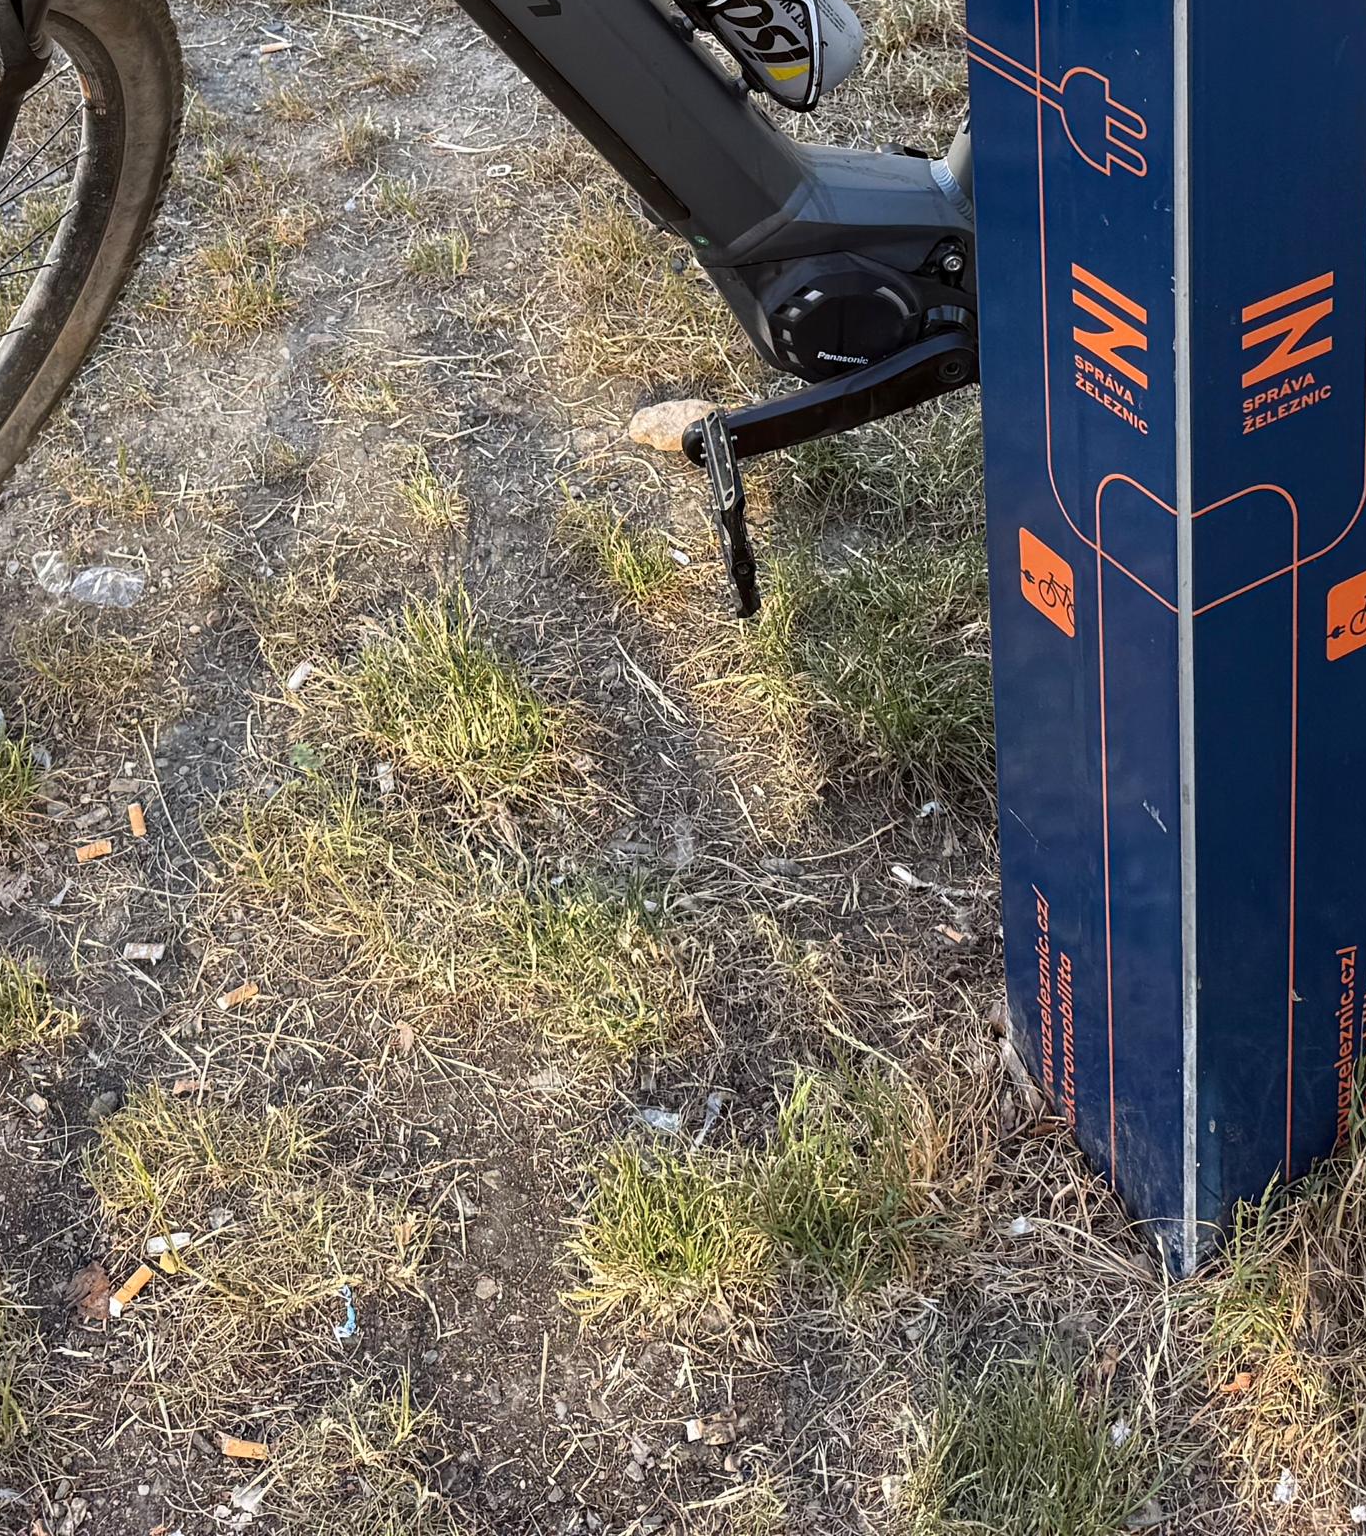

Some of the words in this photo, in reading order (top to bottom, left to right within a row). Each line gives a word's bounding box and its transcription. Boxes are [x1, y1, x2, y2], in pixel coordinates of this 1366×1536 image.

[817, 351, 869, 365] Panasonic
[1073, 354, 1134, 406] SPRÁVA
[1074, 372, 1149, 436] ŽELEZNIC
[1242, 372, 1316, 414] SPRÁVA
[1242, 385, 1333, 435] ŽELEZNIC
